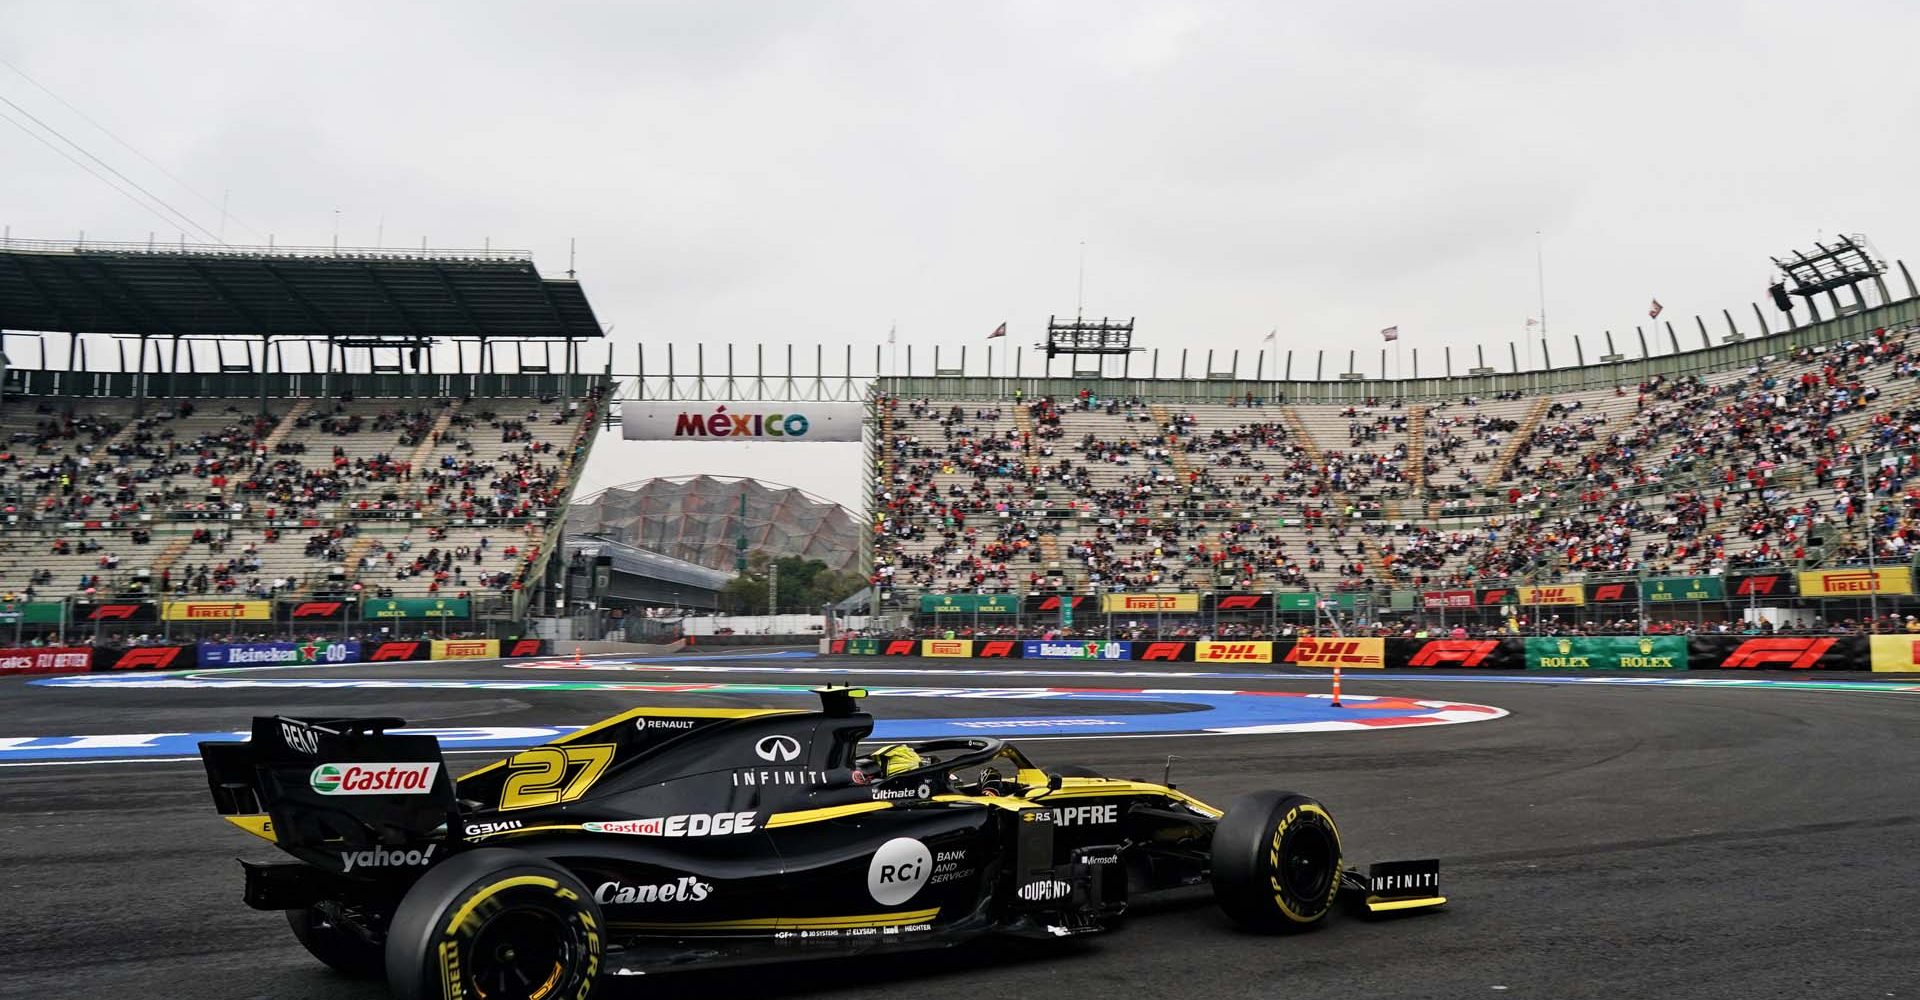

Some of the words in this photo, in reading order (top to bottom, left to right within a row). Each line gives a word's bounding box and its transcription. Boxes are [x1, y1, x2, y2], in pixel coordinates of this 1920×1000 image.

[1125, 597, 1176, 608] PIRELLI
[186, 604, 245, 617] PIRELLI
[228, 648, 297, 662] Heineken
[1208, 645, 1258, 659] DHL
[1298, 642, 1361, 662] DHL
[1541, 657, 1590, 667] ROLEX
[1620, 656, 1673, 668] ROLEX
[648, 720, 694, 729] RENAULT
[342, 766, 430, 791] Castrol
[498, 742, 617, 812] 27
[733, 770, 828, 786] INFINITI
[872, 788, 915, 800] ultimate
[603, 822, 660, 834] Castrol
[664, 811, 757, 836] EDGE
[341, 844, 436, 872] yahoo!
[937, 850, 966, 861] BANK
[934, 863, 957, 873] AND
[1371, 872, 1439, 891] INFINITI
[594, 876, 710, 904] Canel's
